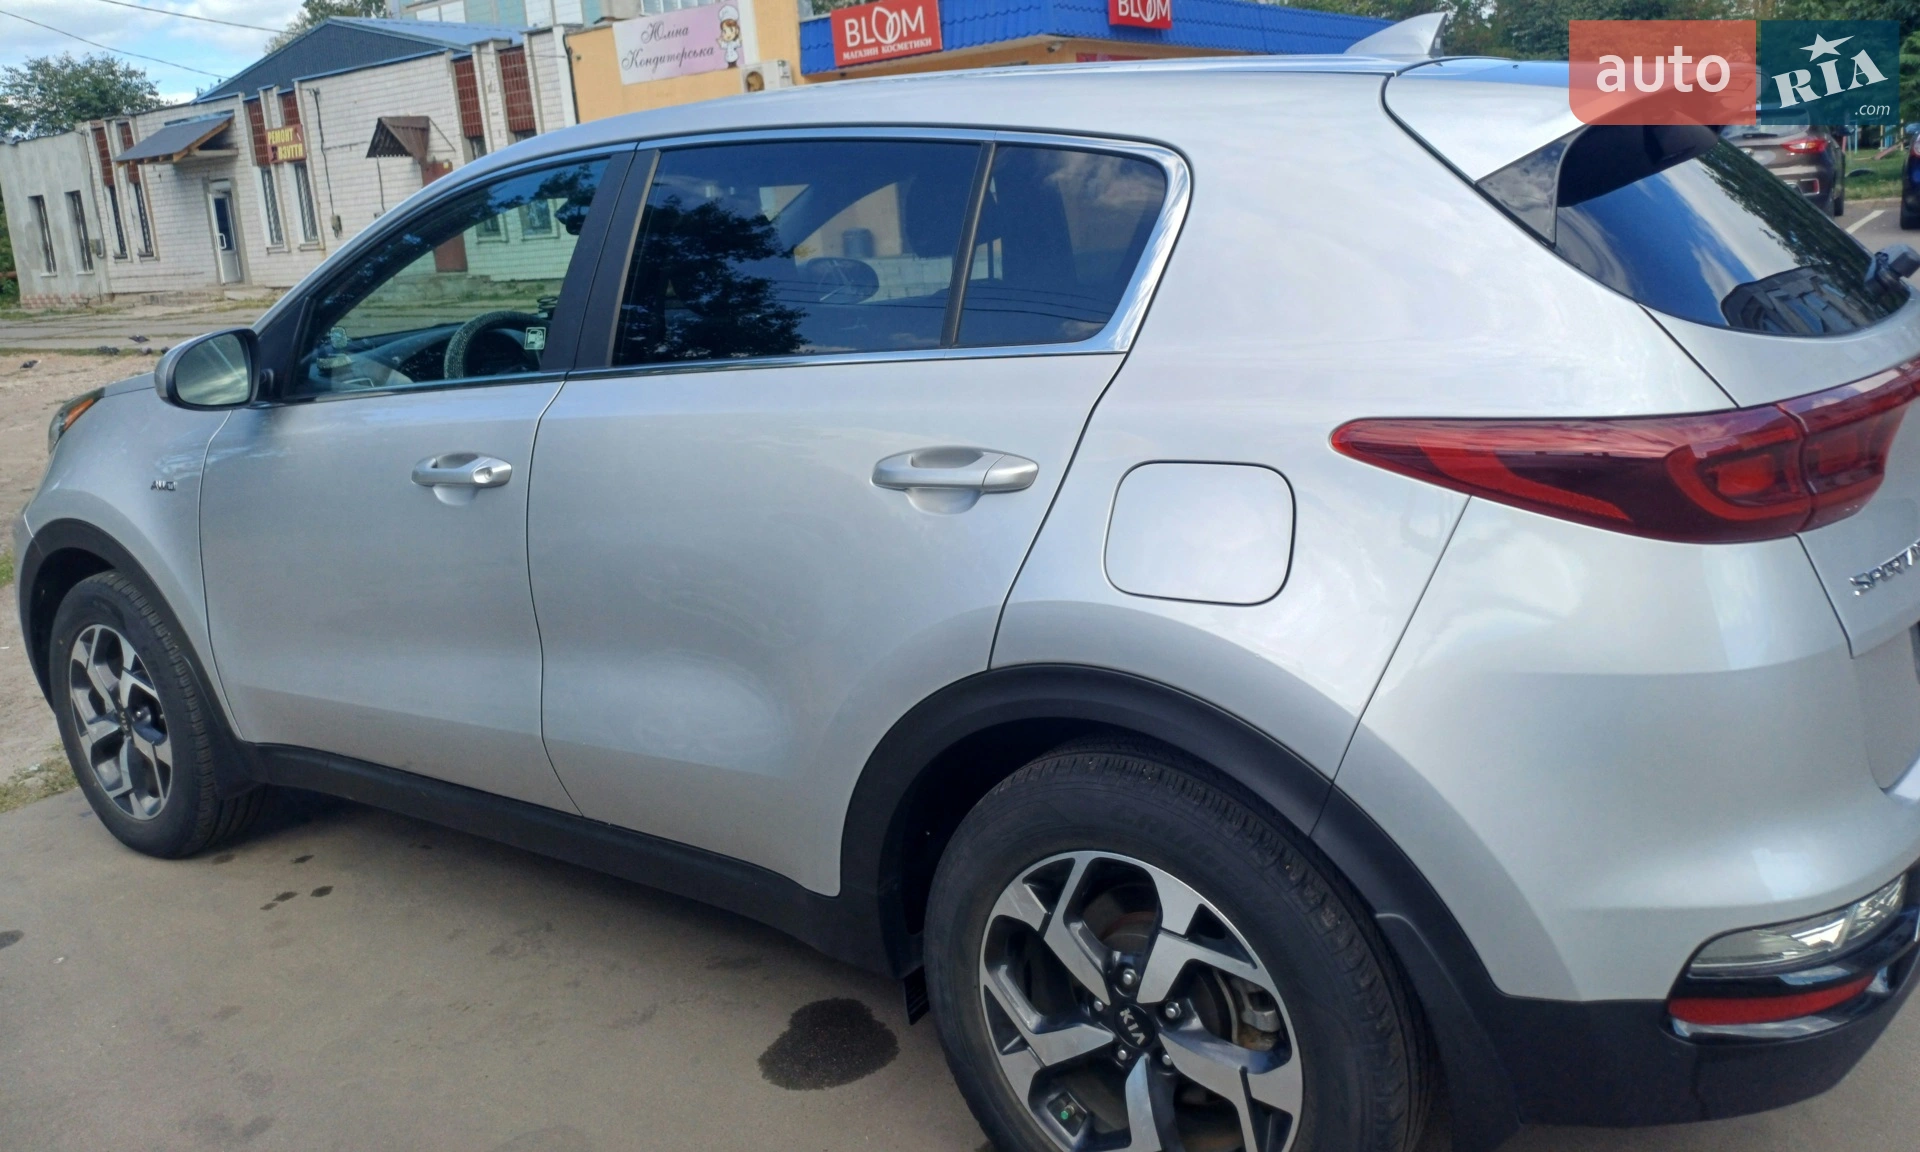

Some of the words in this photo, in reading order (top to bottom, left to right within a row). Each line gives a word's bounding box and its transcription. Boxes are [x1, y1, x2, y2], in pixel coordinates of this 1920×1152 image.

[1117, 0, 1171, 23] BLOOM
[640, 20, 690, 45] Юліна
[844, 5, 926, 48] BLOOM
[621, 45, 715, 74] Кондитерська
[843, 46, 879, 61] МАГАЗИН
[881, 37, 933, 54] КОСМЕТИКИ
[267, 127, 294, 146] РЕМОНТ
[277, 143, 304, 161] ВЗУТТЯ
[1119, 1007, 1146, 1046] KIA
